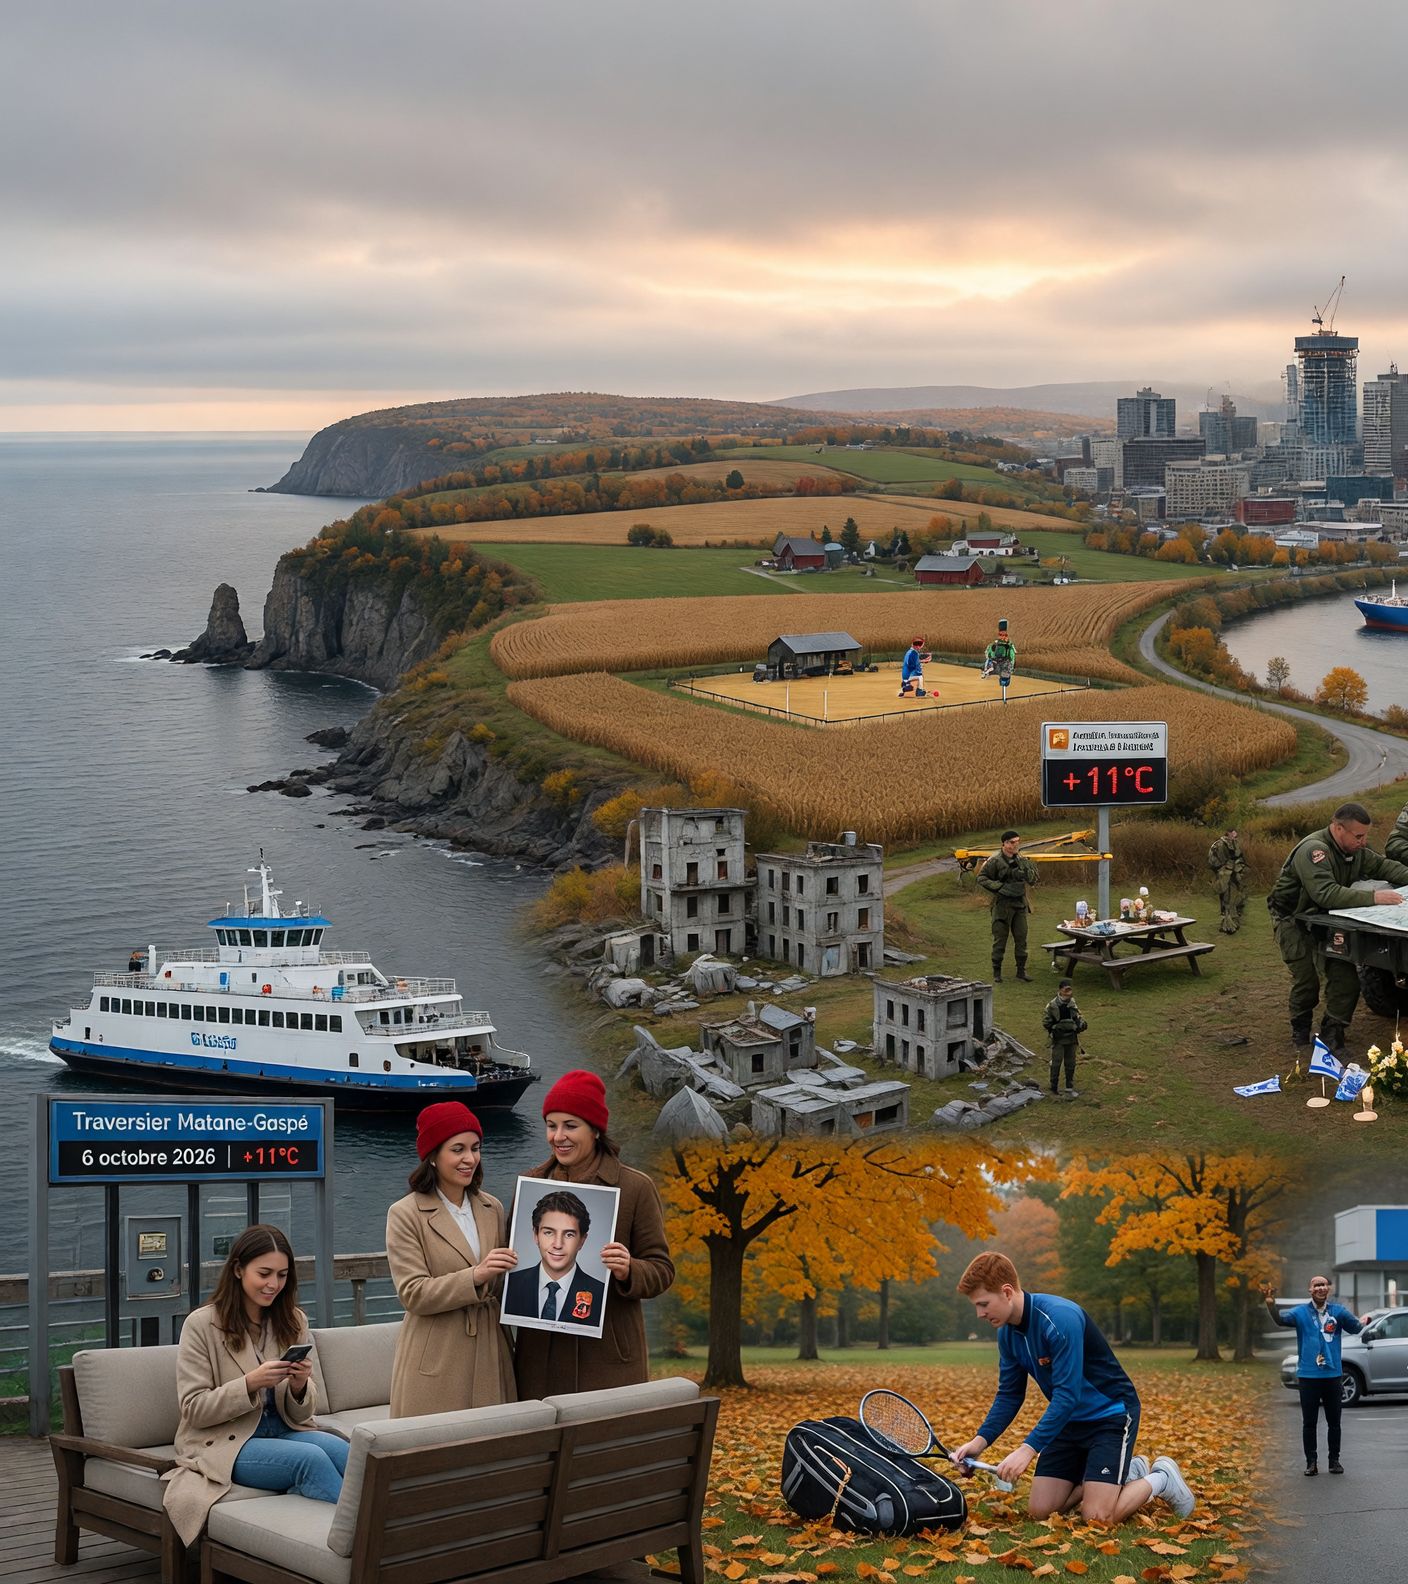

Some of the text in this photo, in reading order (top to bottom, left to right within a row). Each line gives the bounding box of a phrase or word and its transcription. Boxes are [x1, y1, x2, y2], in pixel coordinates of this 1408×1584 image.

[1063, 765, 1154, 795] +11°C
[72, 1111, 308, 1135] Traversier Matane-Gaspé
[81, 1146, 299, 1166] 6 octobre 2026 +11°C
